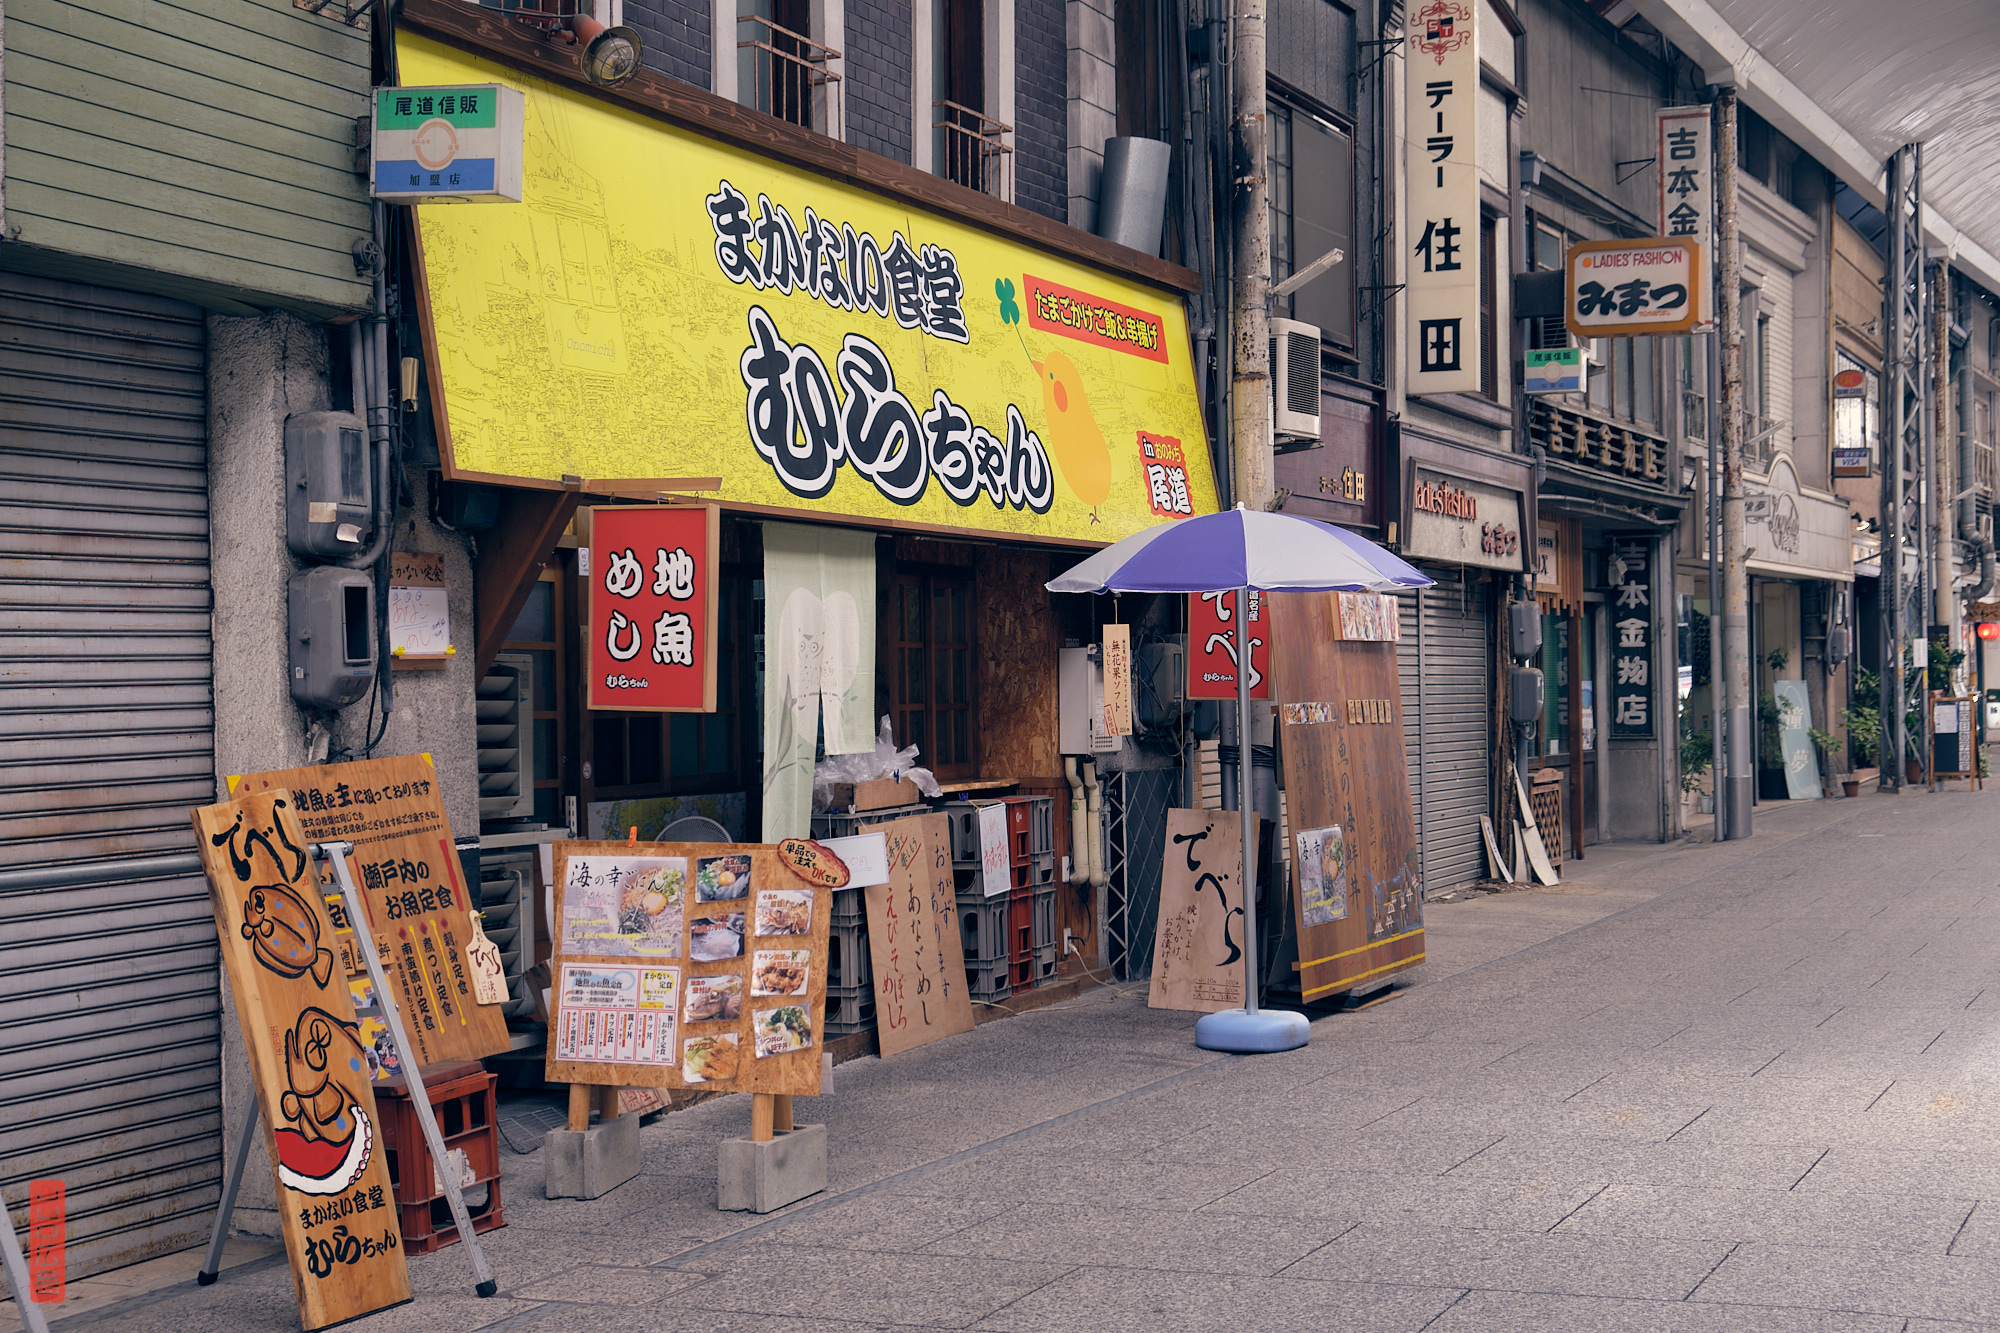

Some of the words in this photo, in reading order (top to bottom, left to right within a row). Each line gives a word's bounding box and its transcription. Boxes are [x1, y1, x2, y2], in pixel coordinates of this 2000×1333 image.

[395, 95, 478, 116] 尾道信販
[409, 173, 461, 186] 加盟店
[1667, 127, 1700, 236] 吉本金
[1415, 80, 1463, 373] テーラー住田
[706, 179, 970, 344] まかない食堂
[1633, 250, 1682, 267] FASHION
[1578, 278, 1687, 317] みまつ
[566, 337, 616, 358] Onomichi
[740, 305, 1054, 514] むらちゃん
[1142, 436, 1156, 459] in
[1154, 441, 1182, 463] おのみち
[1547, 408, 1658, 480] 吉本金物店
[1842, 458, 1860, 466] VISA
[1147, 462, 1192, 515] 尾道
[1442, 481, 1478, 520] fashion
[1482, 521, 1518, 555] みまつ
[605, 547, 644, 662] めし
[652, 546, 695, 667] 地魚
[1615, 541, 1650, 726] 吉本金物店
[605, 673, 649, 689] むらちゃん
[292, 780, 430, 812] 地魚を主に扱っております
[300, 812, 365, 829] 注文の種類は同じでも
[212, 799, 306, 885] でべら
[785, 841, 817, 860] 単品での
[361, 859, 430, 891] 瀬戸内の
[570, 861, 666, 891] 海の幸ごはん
[794, 856, 817, 870] 注文も
[811, 867, 838, 884] OKです
[384, 884, 455, 921] お魚定食
[1173, 823, 1244, 967] でべら
[1185, 904, 1197, 961] 焼いてよし
[908, 882, 931, 1026] あなごめし
[422, 937, 453, 1018] 煮つけ定食
[643, 972, 670, 980] まかない
[659, 981, 673, 989] 定食
[882, 971, 897, 1030] めし
[607, 1013, 615, 1043] カツ定食
[659, 1021, 668, 1056] おかず定食
[299, 1184, 385, 1229] まかない食堂
[305, 1225, 397, 1278] むらちゃん
